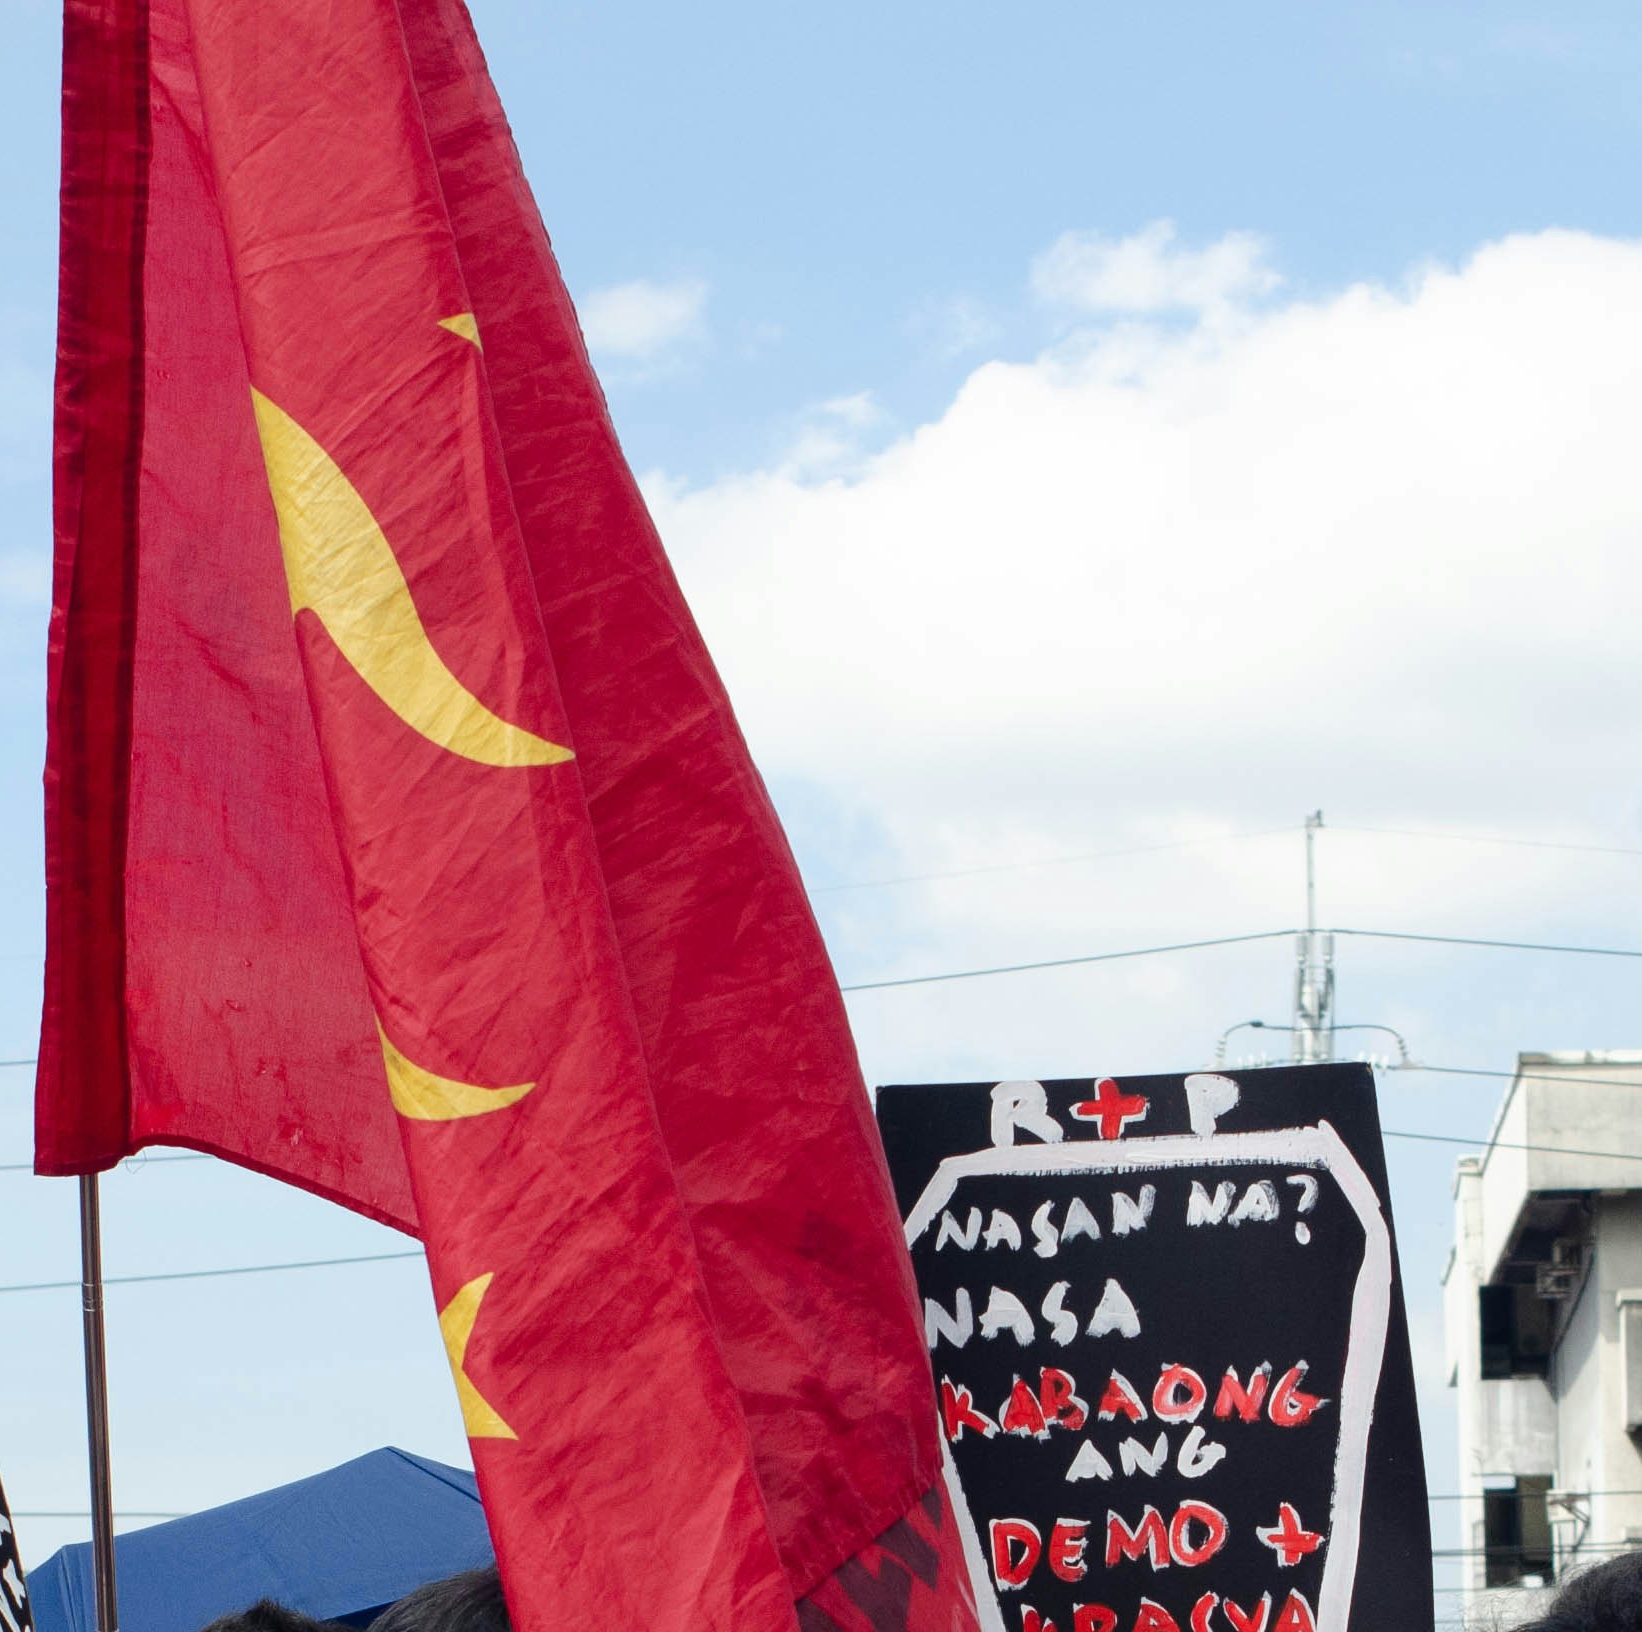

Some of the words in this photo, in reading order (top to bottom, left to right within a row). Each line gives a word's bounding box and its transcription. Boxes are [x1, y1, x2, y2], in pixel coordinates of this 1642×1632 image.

[936, 1184, 1157, 1259] NASAN
[1186, 1174, 1319, 1246] NA?
[924, 1277, 1142, 1349] NASA
[941, 1359, 1331, 1442] KABAONG
[1065, 1425, 1227, 1484] ANG
[989, 1499, 1229, 1592] DEMO
